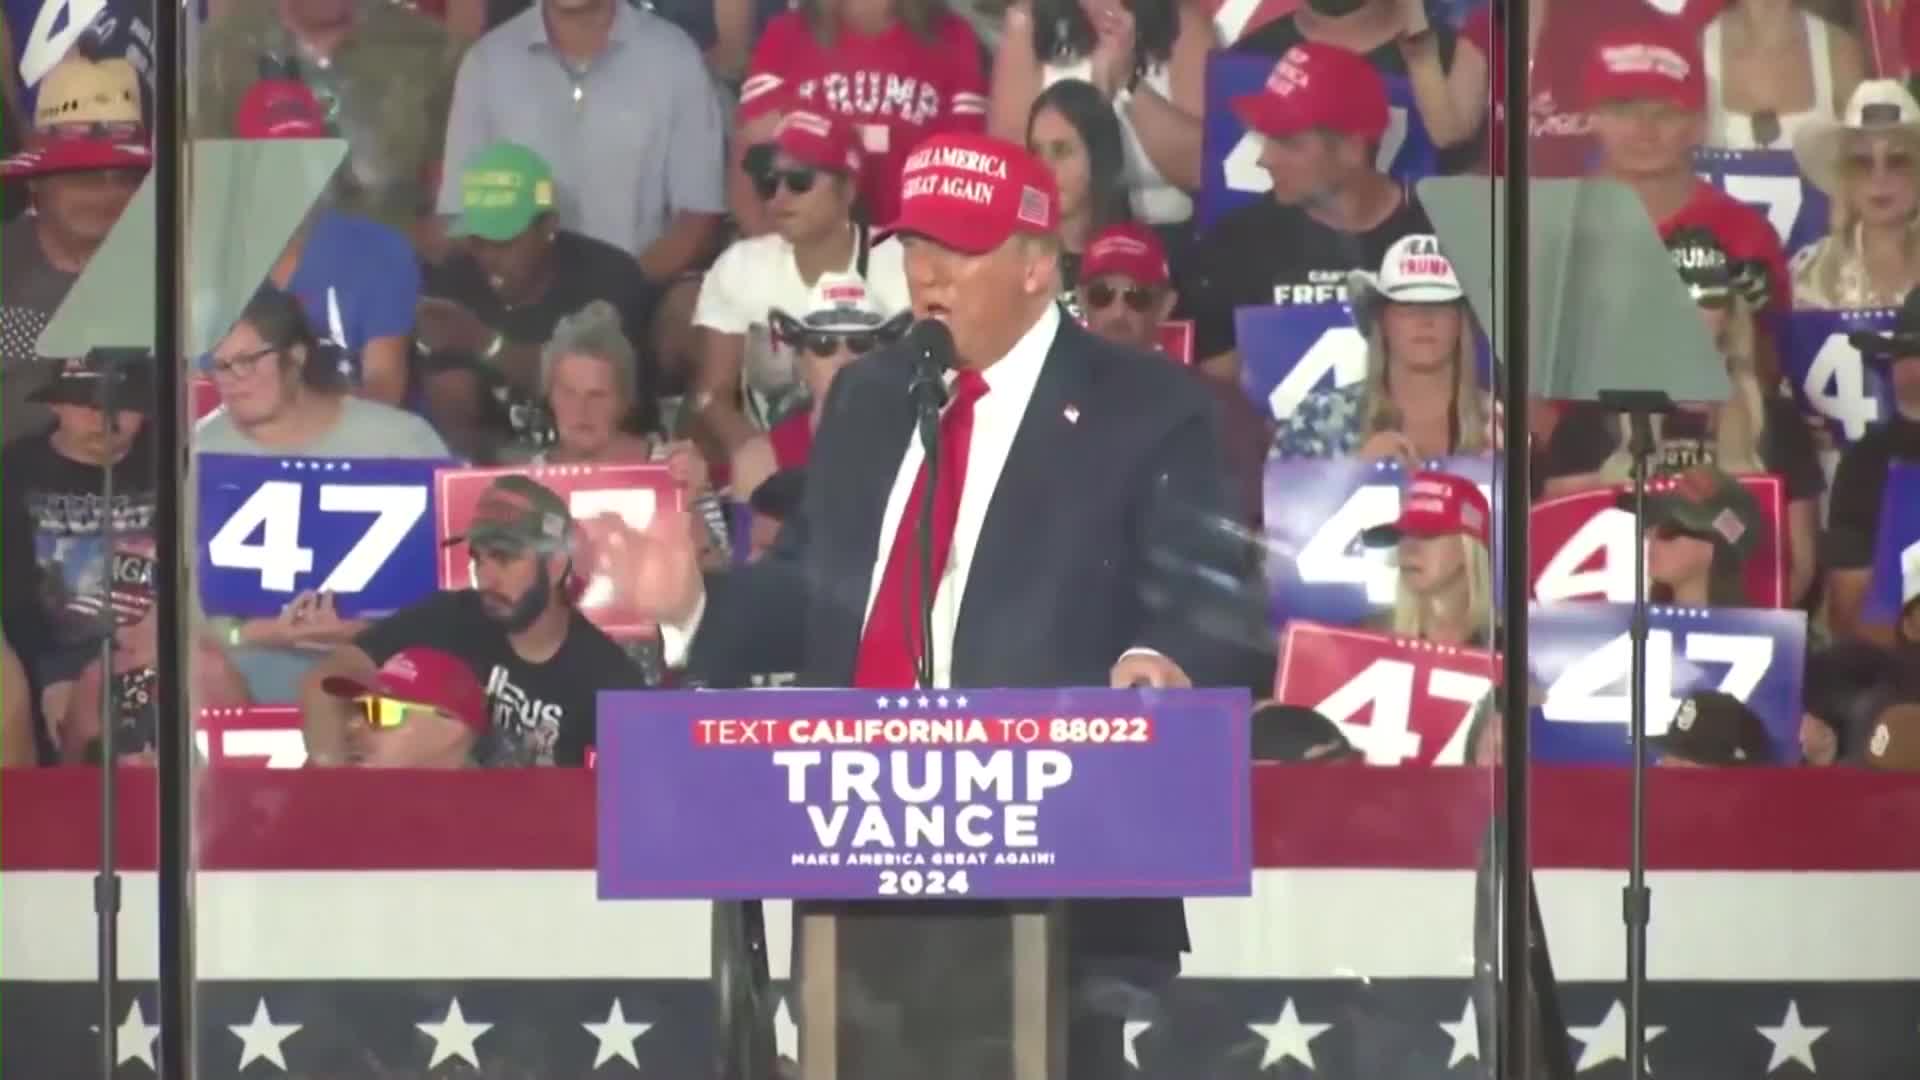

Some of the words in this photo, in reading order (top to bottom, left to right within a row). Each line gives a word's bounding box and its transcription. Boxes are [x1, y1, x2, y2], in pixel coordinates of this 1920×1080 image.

[930, 146, 1007, 181] AMERICA
[937, 177, 995, 207] AGAIN
[1696, 172, 1803, 248] 7
[208, 481, 428, 593] 47
[1541, 628, 1774, 738] 47
[699, 719, 778, 744] TEXT
[787, 718, 988, 744] CALIFORNIA
[999, 718, 1040, 743] TO
[1049, 717, 1149, 743] 88022
[1313, 657, 1492, 766] 47
[772, 750, 1073, 803] TRUMP
[806, 804, 1039, 848] VANCE
[791, 853, 840, 866] MAKE
[846, 852, 925, 866] AMERICA
[931, 852, 989, 866] GREAT
[994, 852, 1055, 866] AGAIN!
[877, 870, 970, 895] 2024
